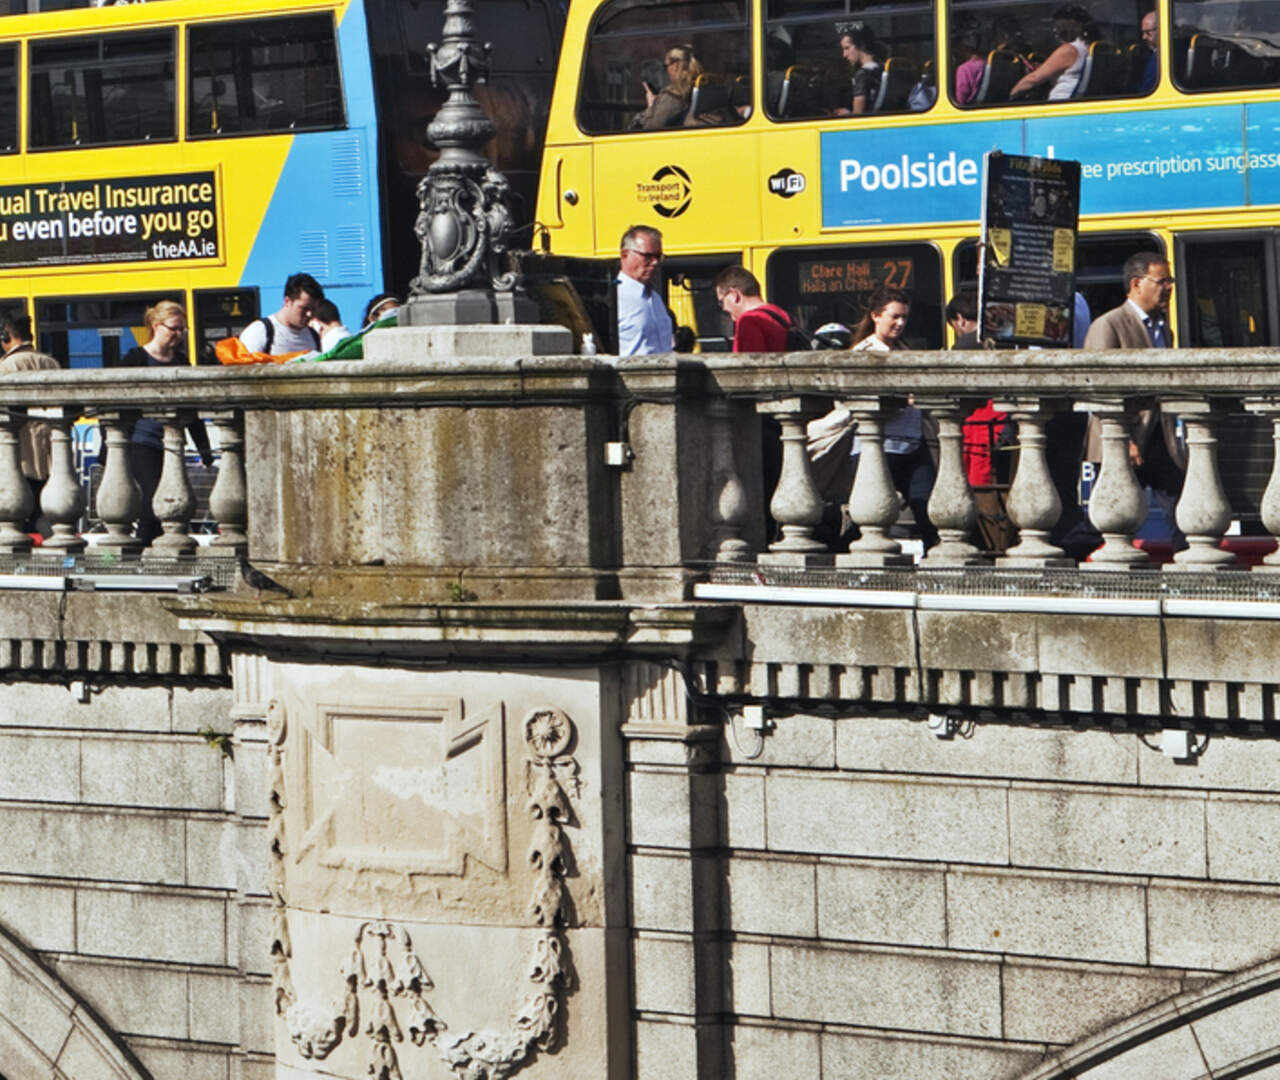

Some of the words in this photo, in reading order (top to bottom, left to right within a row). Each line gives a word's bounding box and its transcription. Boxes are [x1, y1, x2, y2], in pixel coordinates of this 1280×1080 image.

[840, 151, 978, 192] Poolside
[1081, 162, 1103, 178] ee
[1107, 154, 1202, 181] prescription
[35, 184, 101, 213] Travel
[105, 182, 213, 209] Insurance
[637, 182, 680, 194] Transport
[649, 192, 680, 202] Ireland
[12, 218, 64, 241] even
[68, 210, 137, 238] before
[140, 211, 182, 240] you
[187, 209, 214, 237] go
[152, 238, 215, 259] theAA.ie
[811, 264, 843, 279] Clare
[846, 261, 870, 277] Hall
[884, 260, 912, 289] 27
